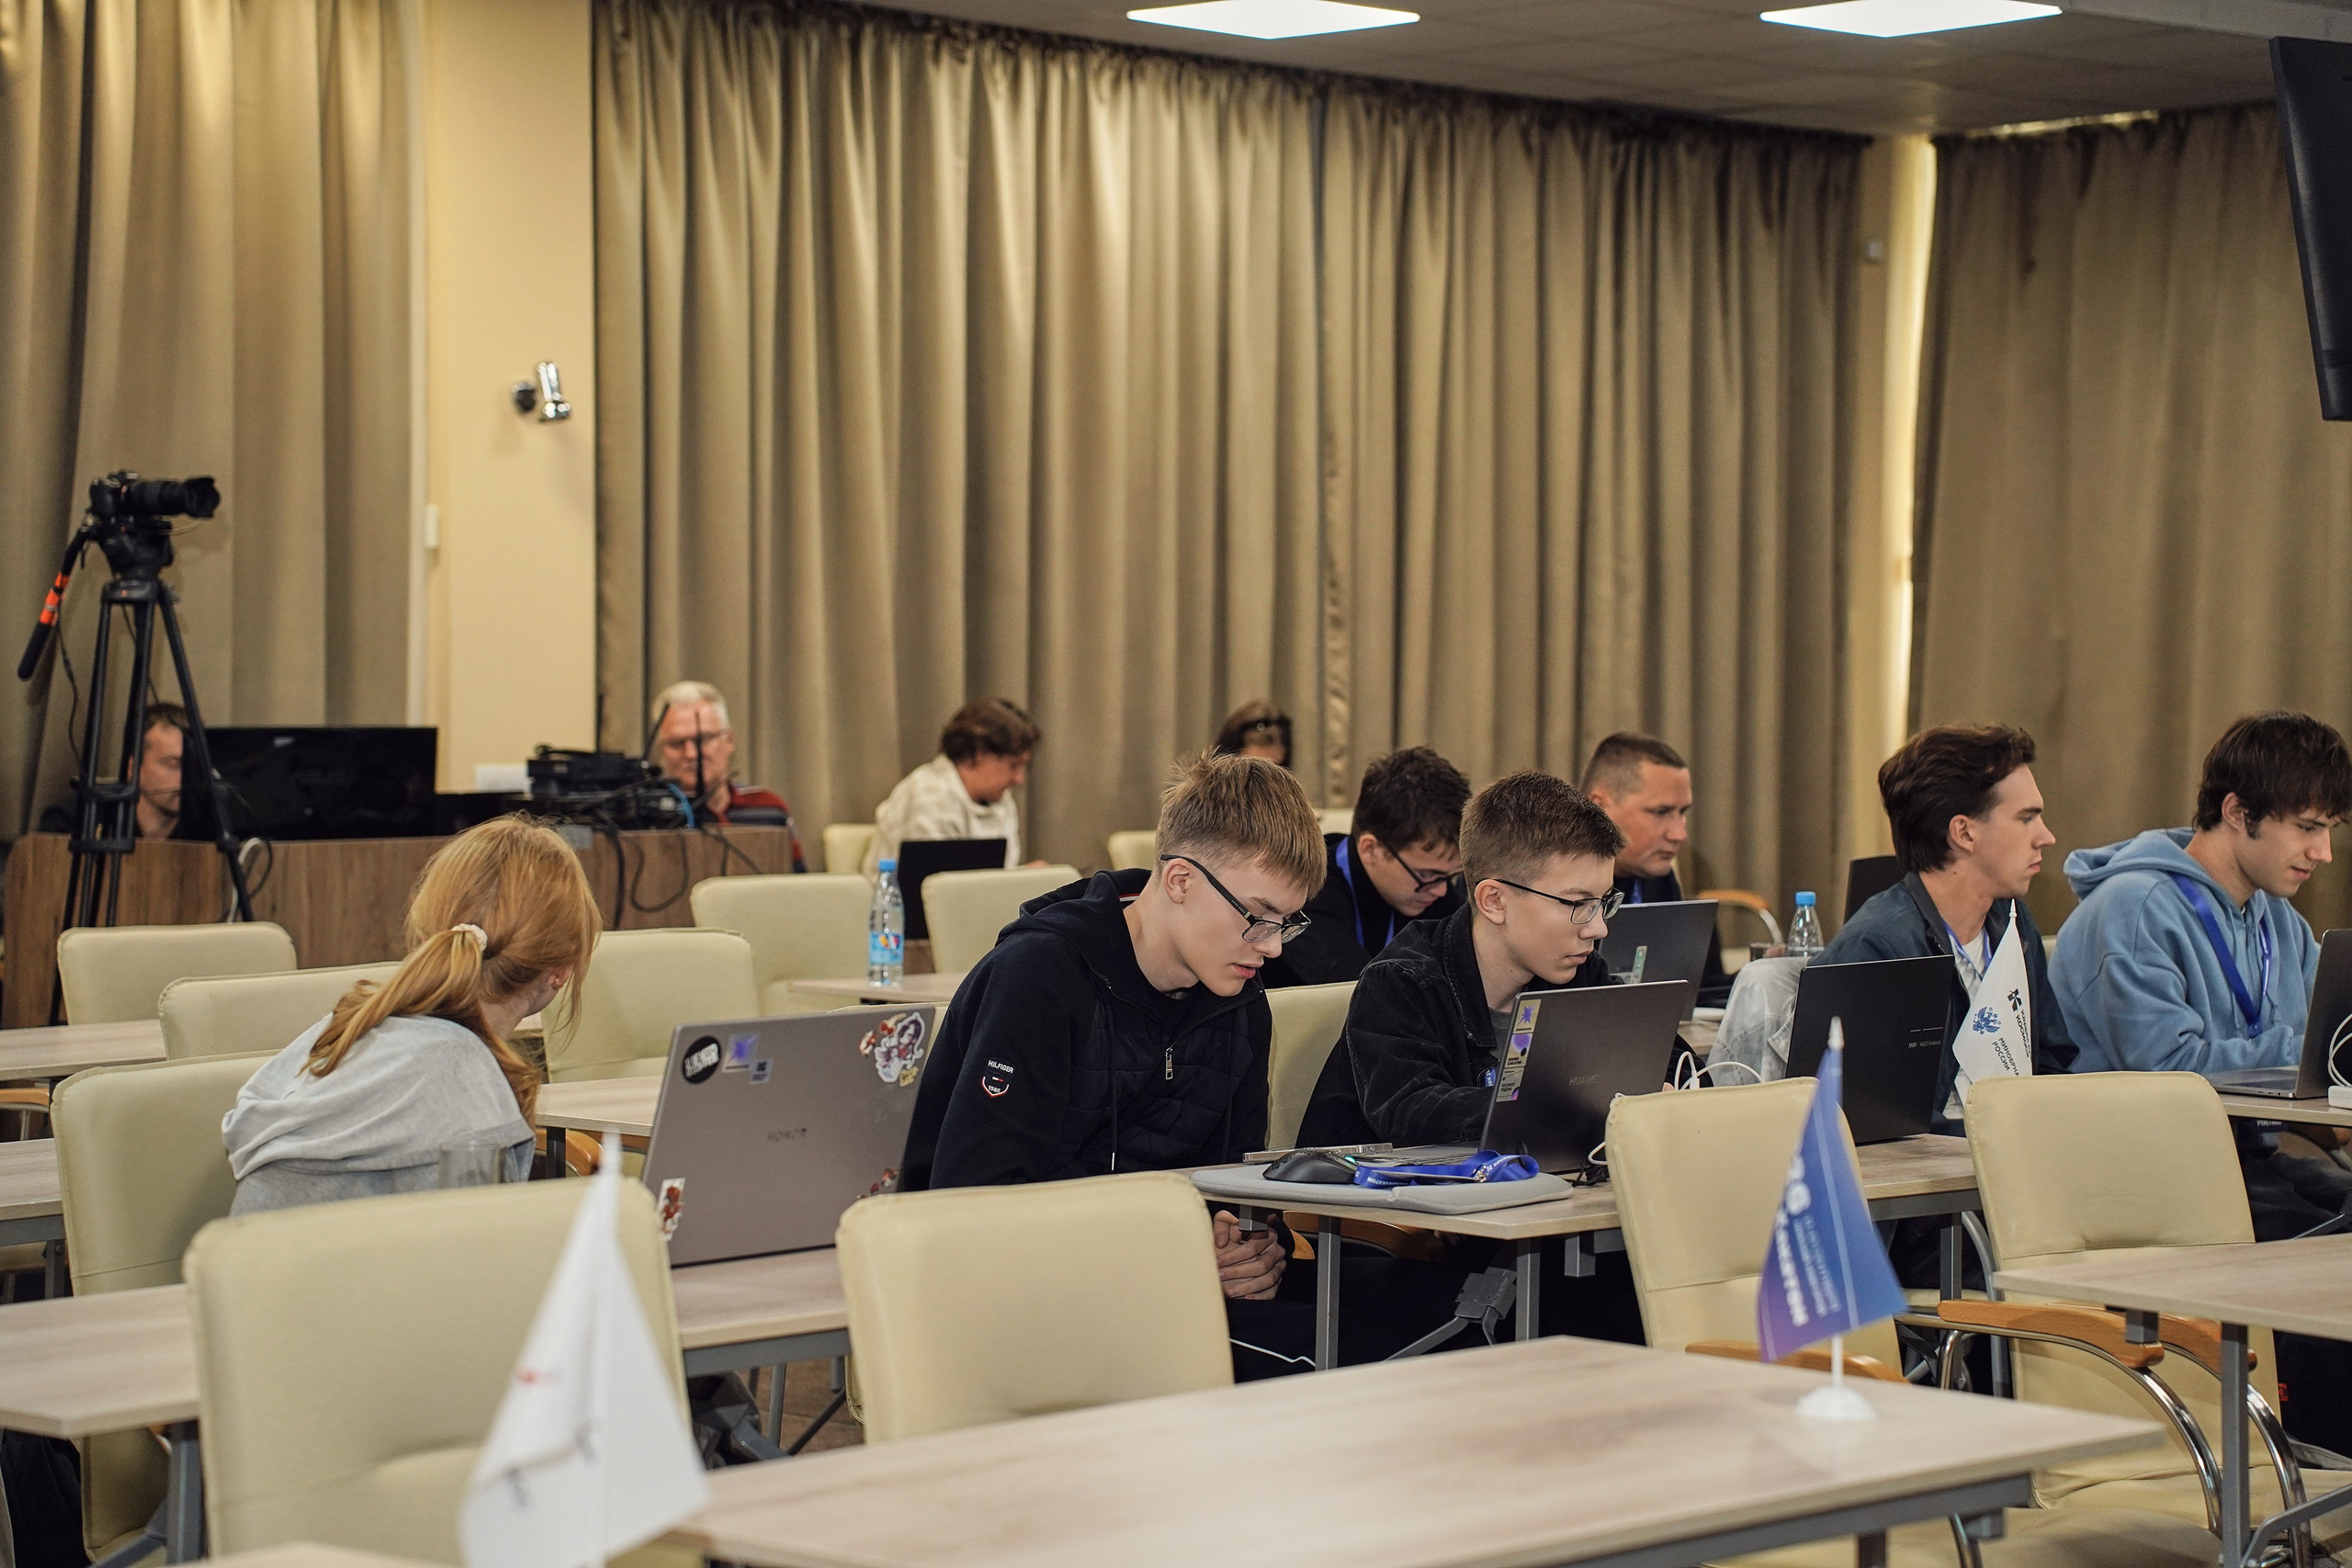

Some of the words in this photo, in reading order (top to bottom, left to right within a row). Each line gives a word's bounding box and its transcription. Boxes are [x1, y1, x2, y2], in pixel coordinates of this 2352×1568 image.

[1992, 1041, 2010, 1071] РОССИИ
[988, 1059, 1014, 1074] HILFIGER
[988, 1085, 1001, 1093] 1985
